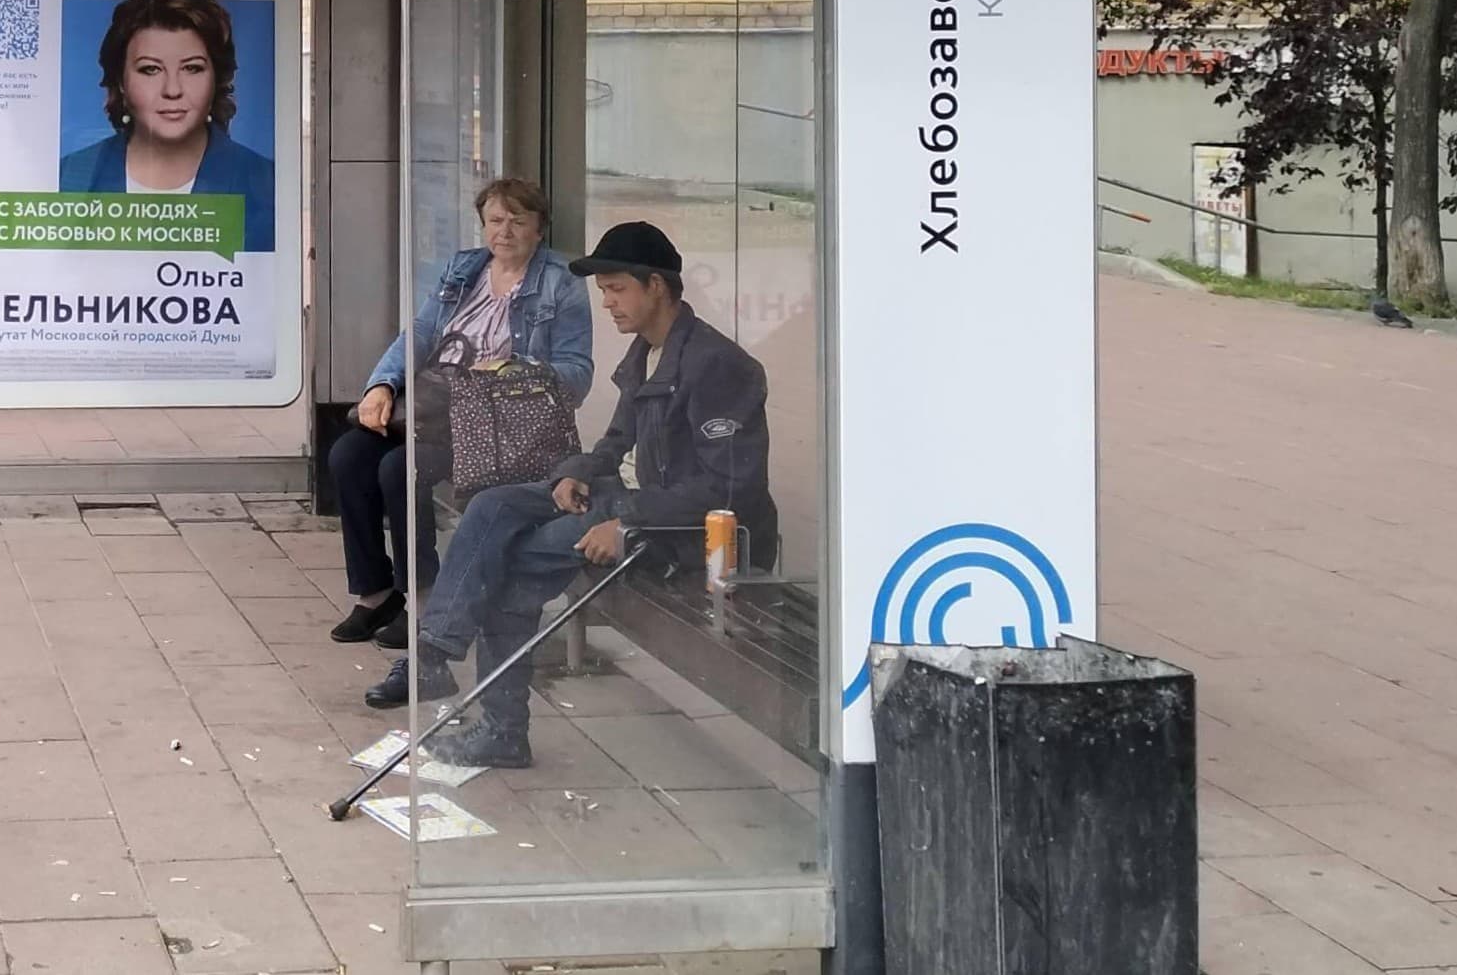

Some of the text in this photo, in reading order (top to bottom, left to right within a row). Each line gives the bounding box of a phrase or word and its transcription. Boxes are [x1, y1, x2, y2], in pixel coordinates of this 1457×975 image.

[1097, 50, 1225, 76] ДУКТЫ
[13, 200, 104, 218] ЗАБОТОЙ
[108, 203, 123, 218] О
[127, 204, 198, 220] ЛЮДЯХ
[12, 225, 115, 241] ЛЮБОВЬЮ
[121, 227, 132, 241] К
[137, 228, 220, 243] МОСКВЕ!
[156, 262, 244, 288] Ольга
[31, 328, 119, 342] Московской
[123, 329, 197, 344] городской
[201, 330, 241, 344] Думы
